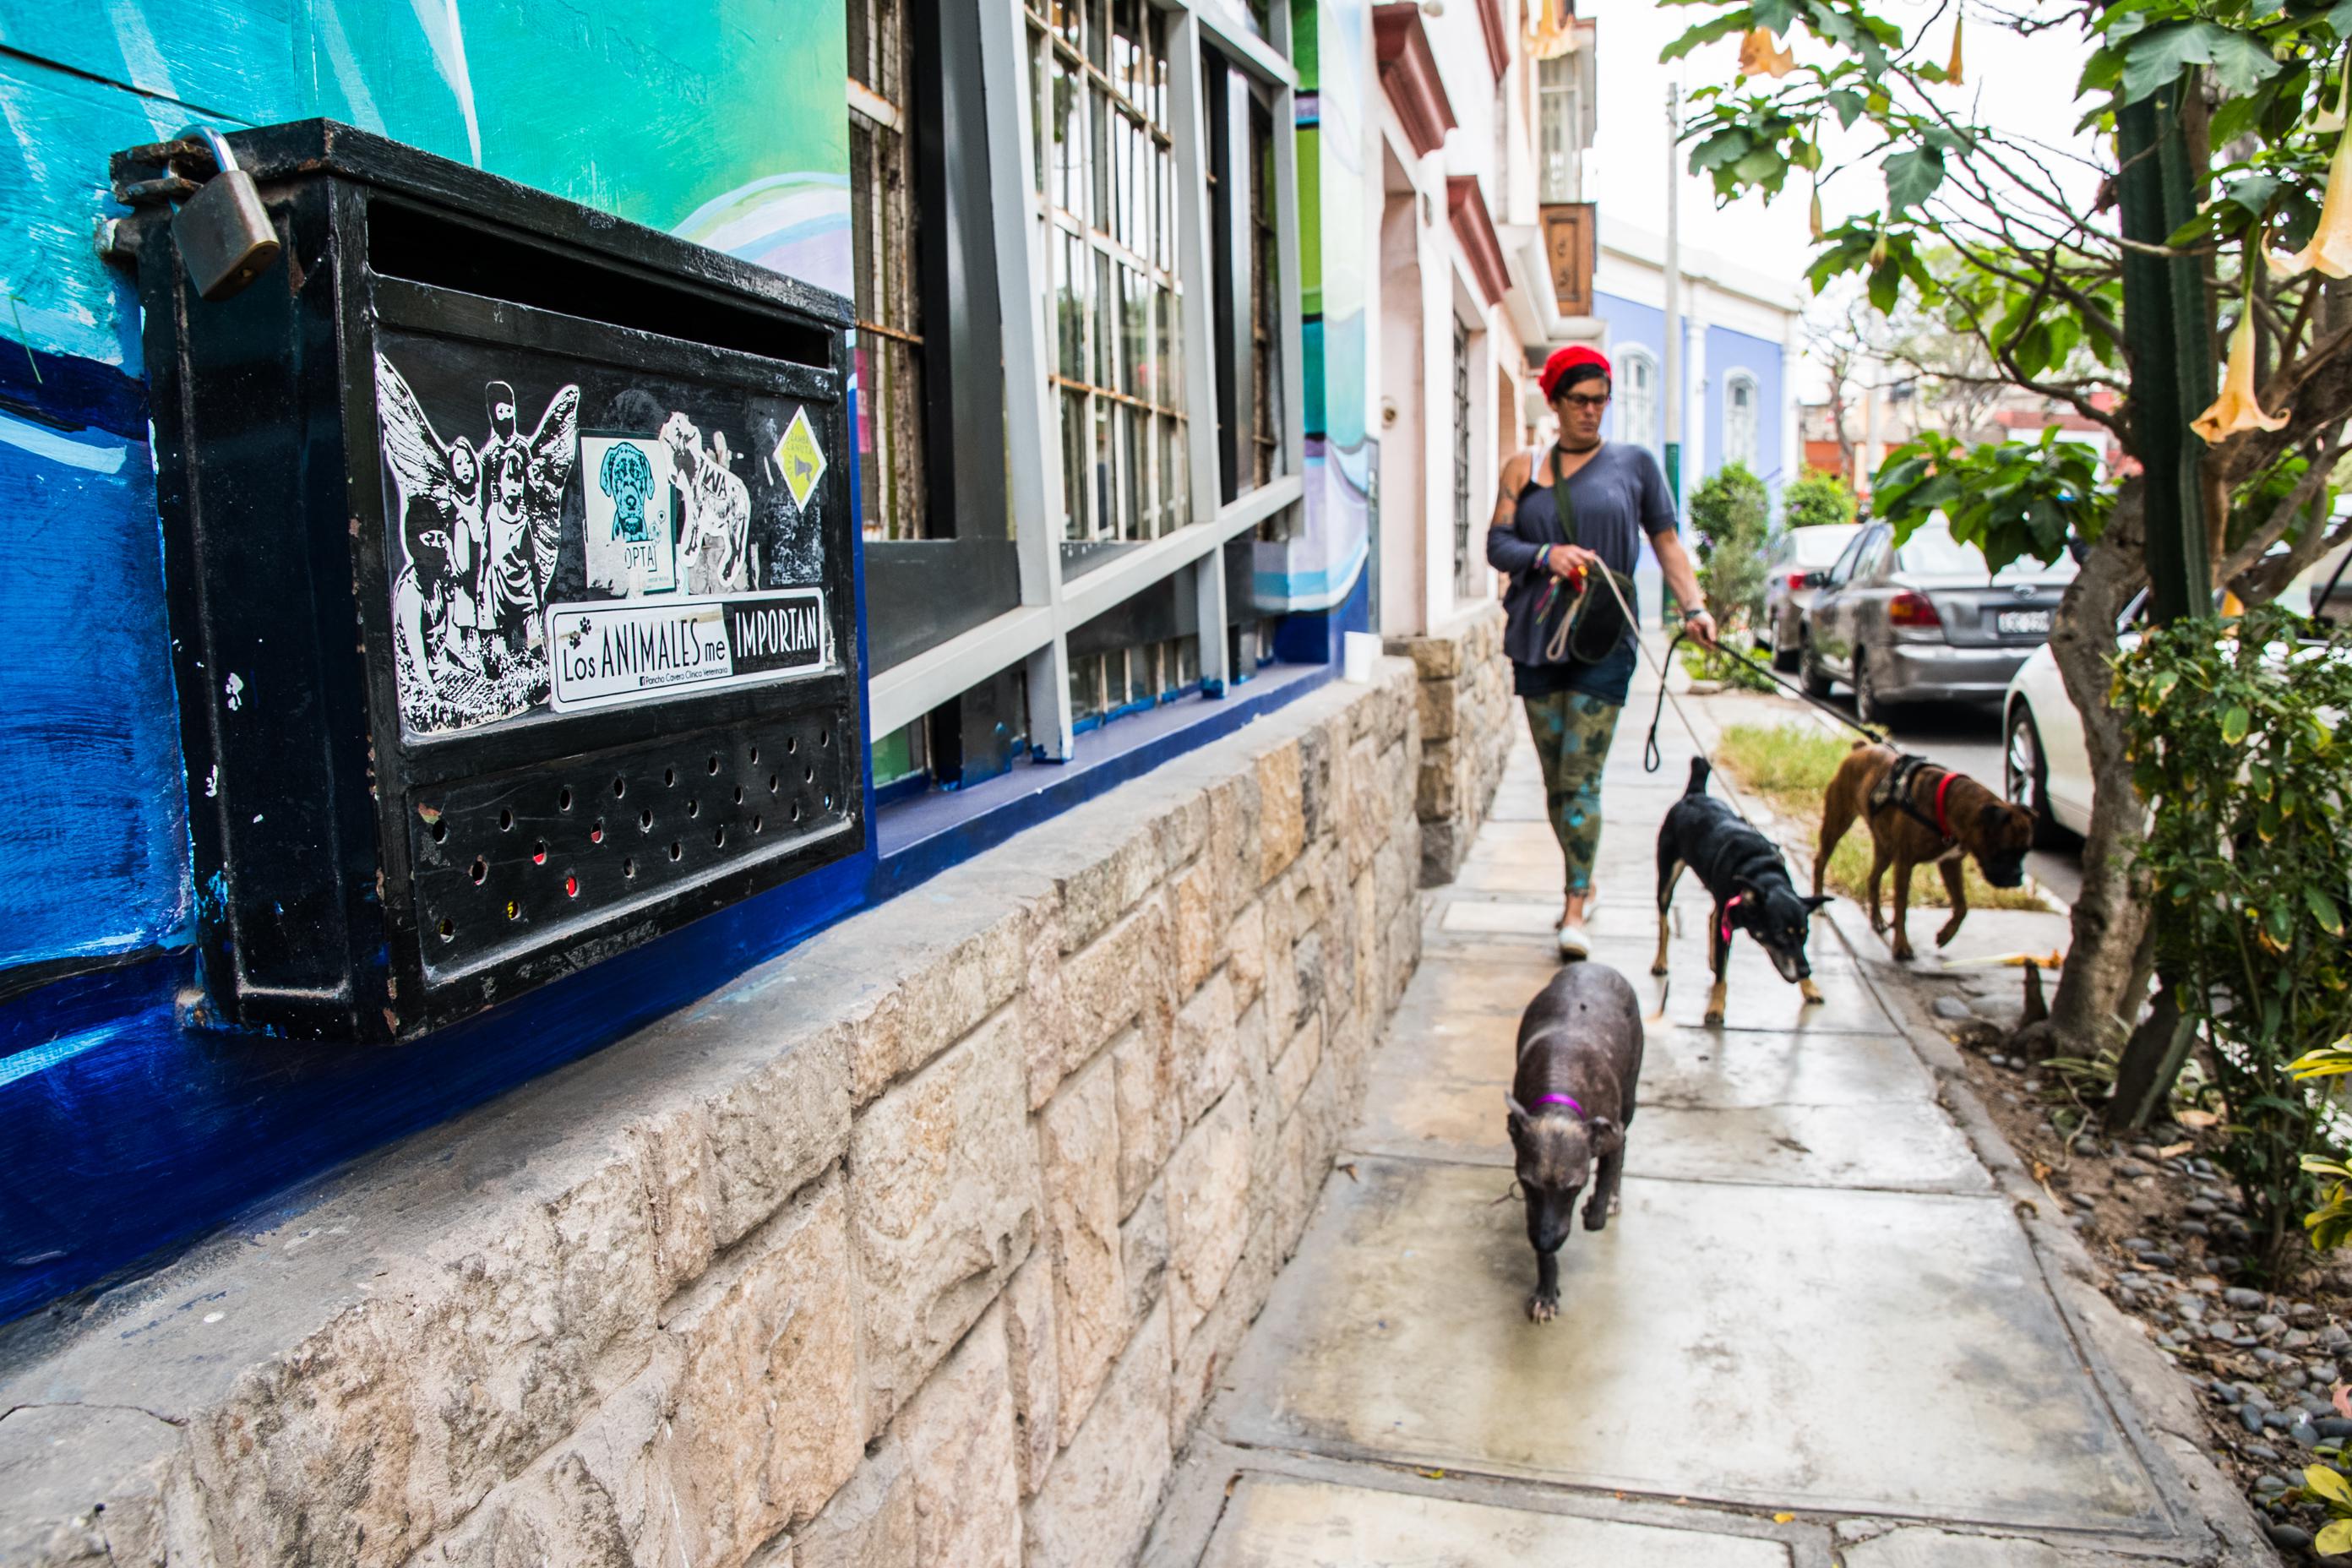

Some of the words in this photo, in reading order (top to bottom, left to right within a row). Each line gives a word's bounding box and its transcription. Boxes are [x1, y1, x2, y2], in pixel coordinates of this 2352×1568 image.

[564, 649, 596, 682] Los
[602, 618, 700, 678] ANIMALES
[705, 640, 726, 662] me
[736, 607, 817, 658] IMPORTAN
